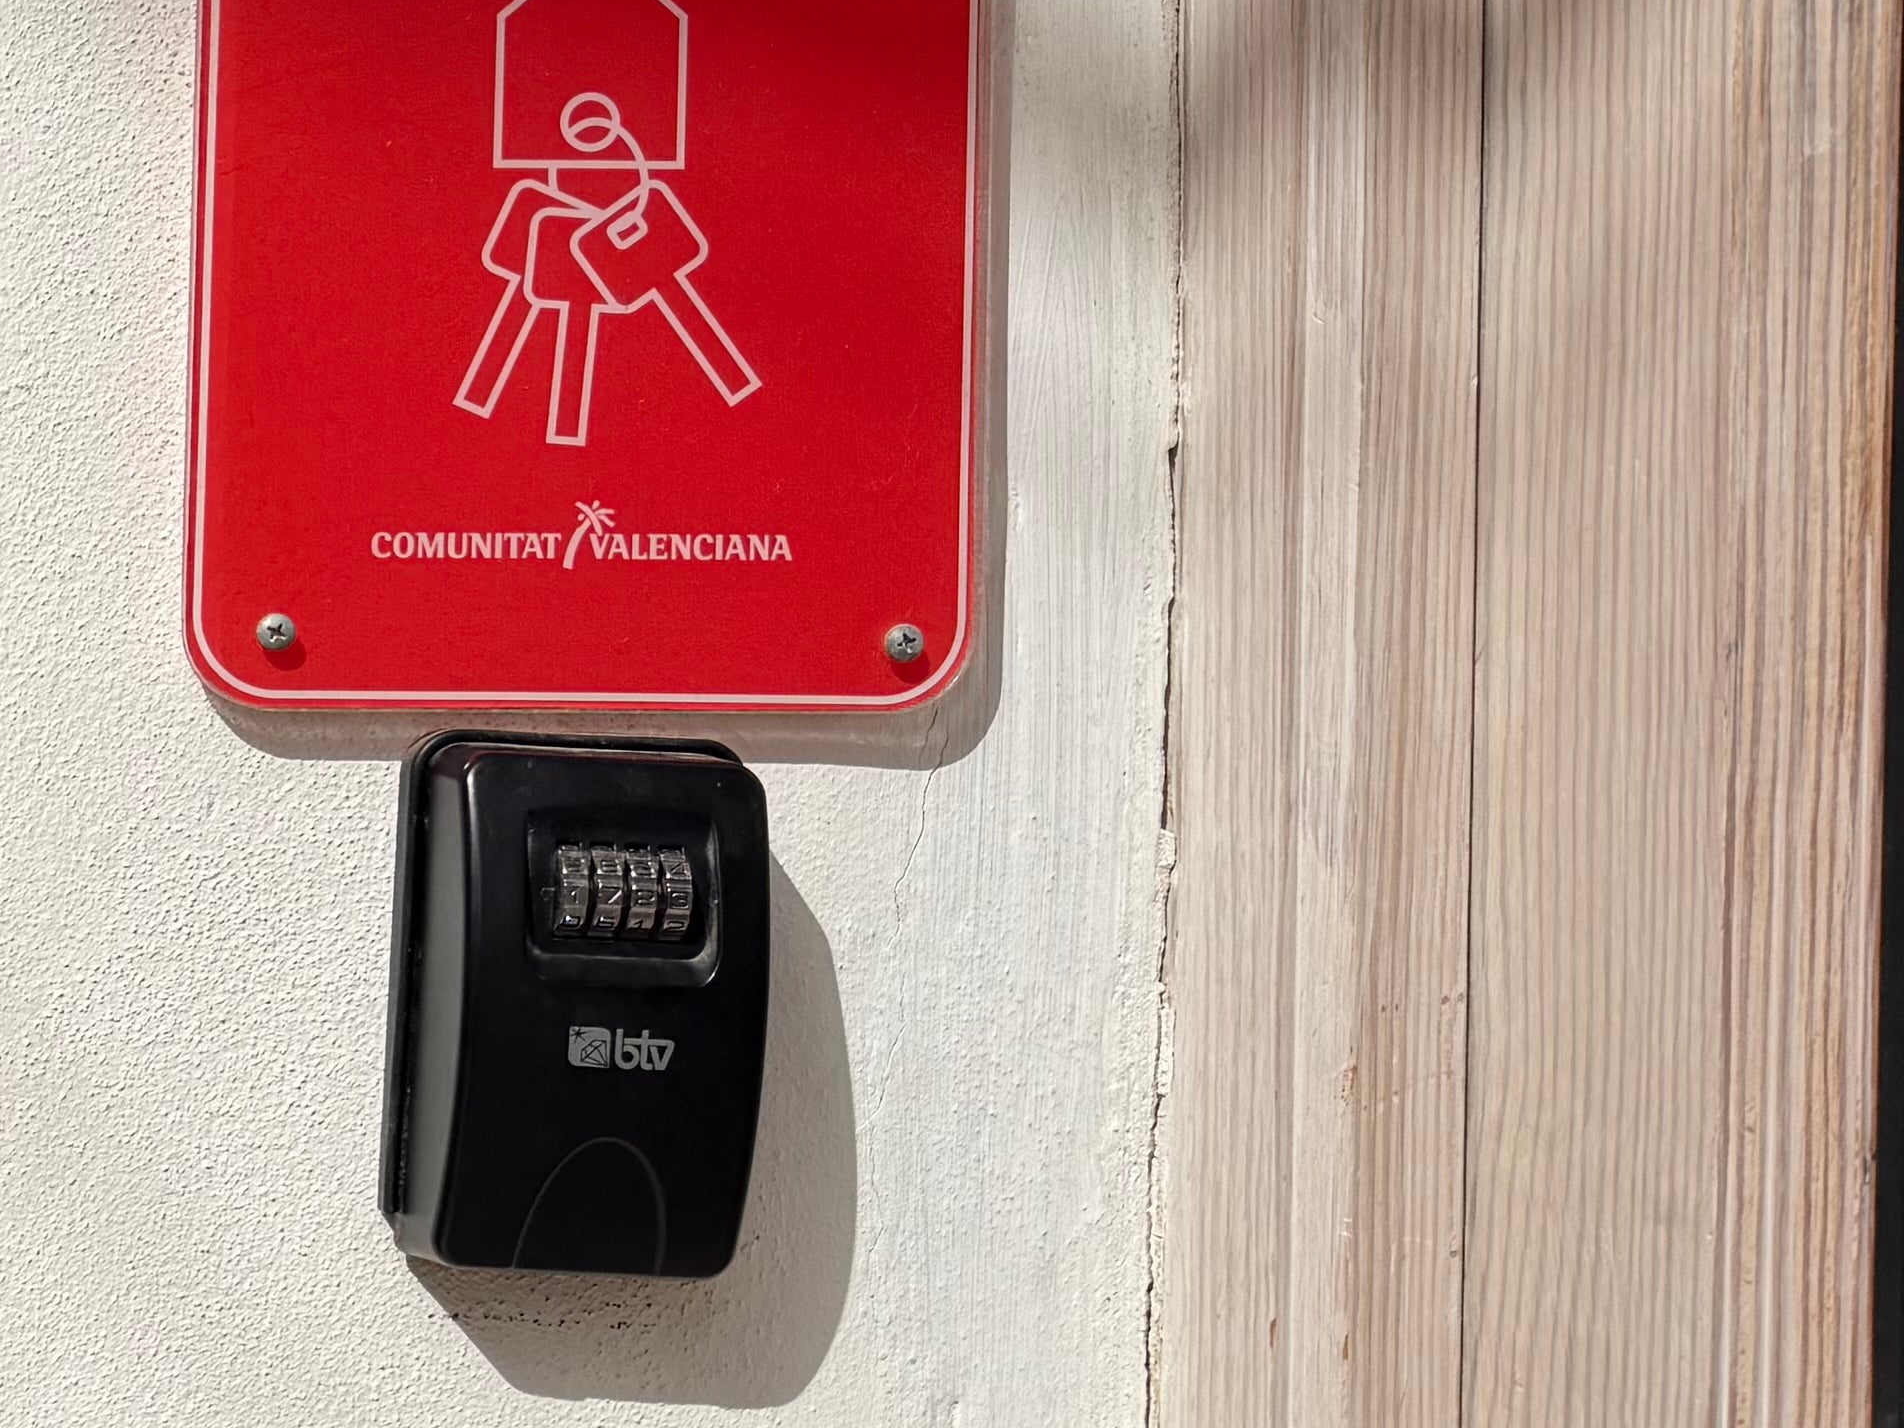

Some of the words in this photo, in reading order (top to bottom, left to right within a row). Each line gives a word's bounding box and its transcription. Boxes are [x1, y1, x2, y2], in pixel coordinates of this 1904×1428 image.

[370, 530, 561, 560] COMUNITAT
[589, 532, 793, 562] VALENCIANA
[614, 1028, 676, 1071] btv
